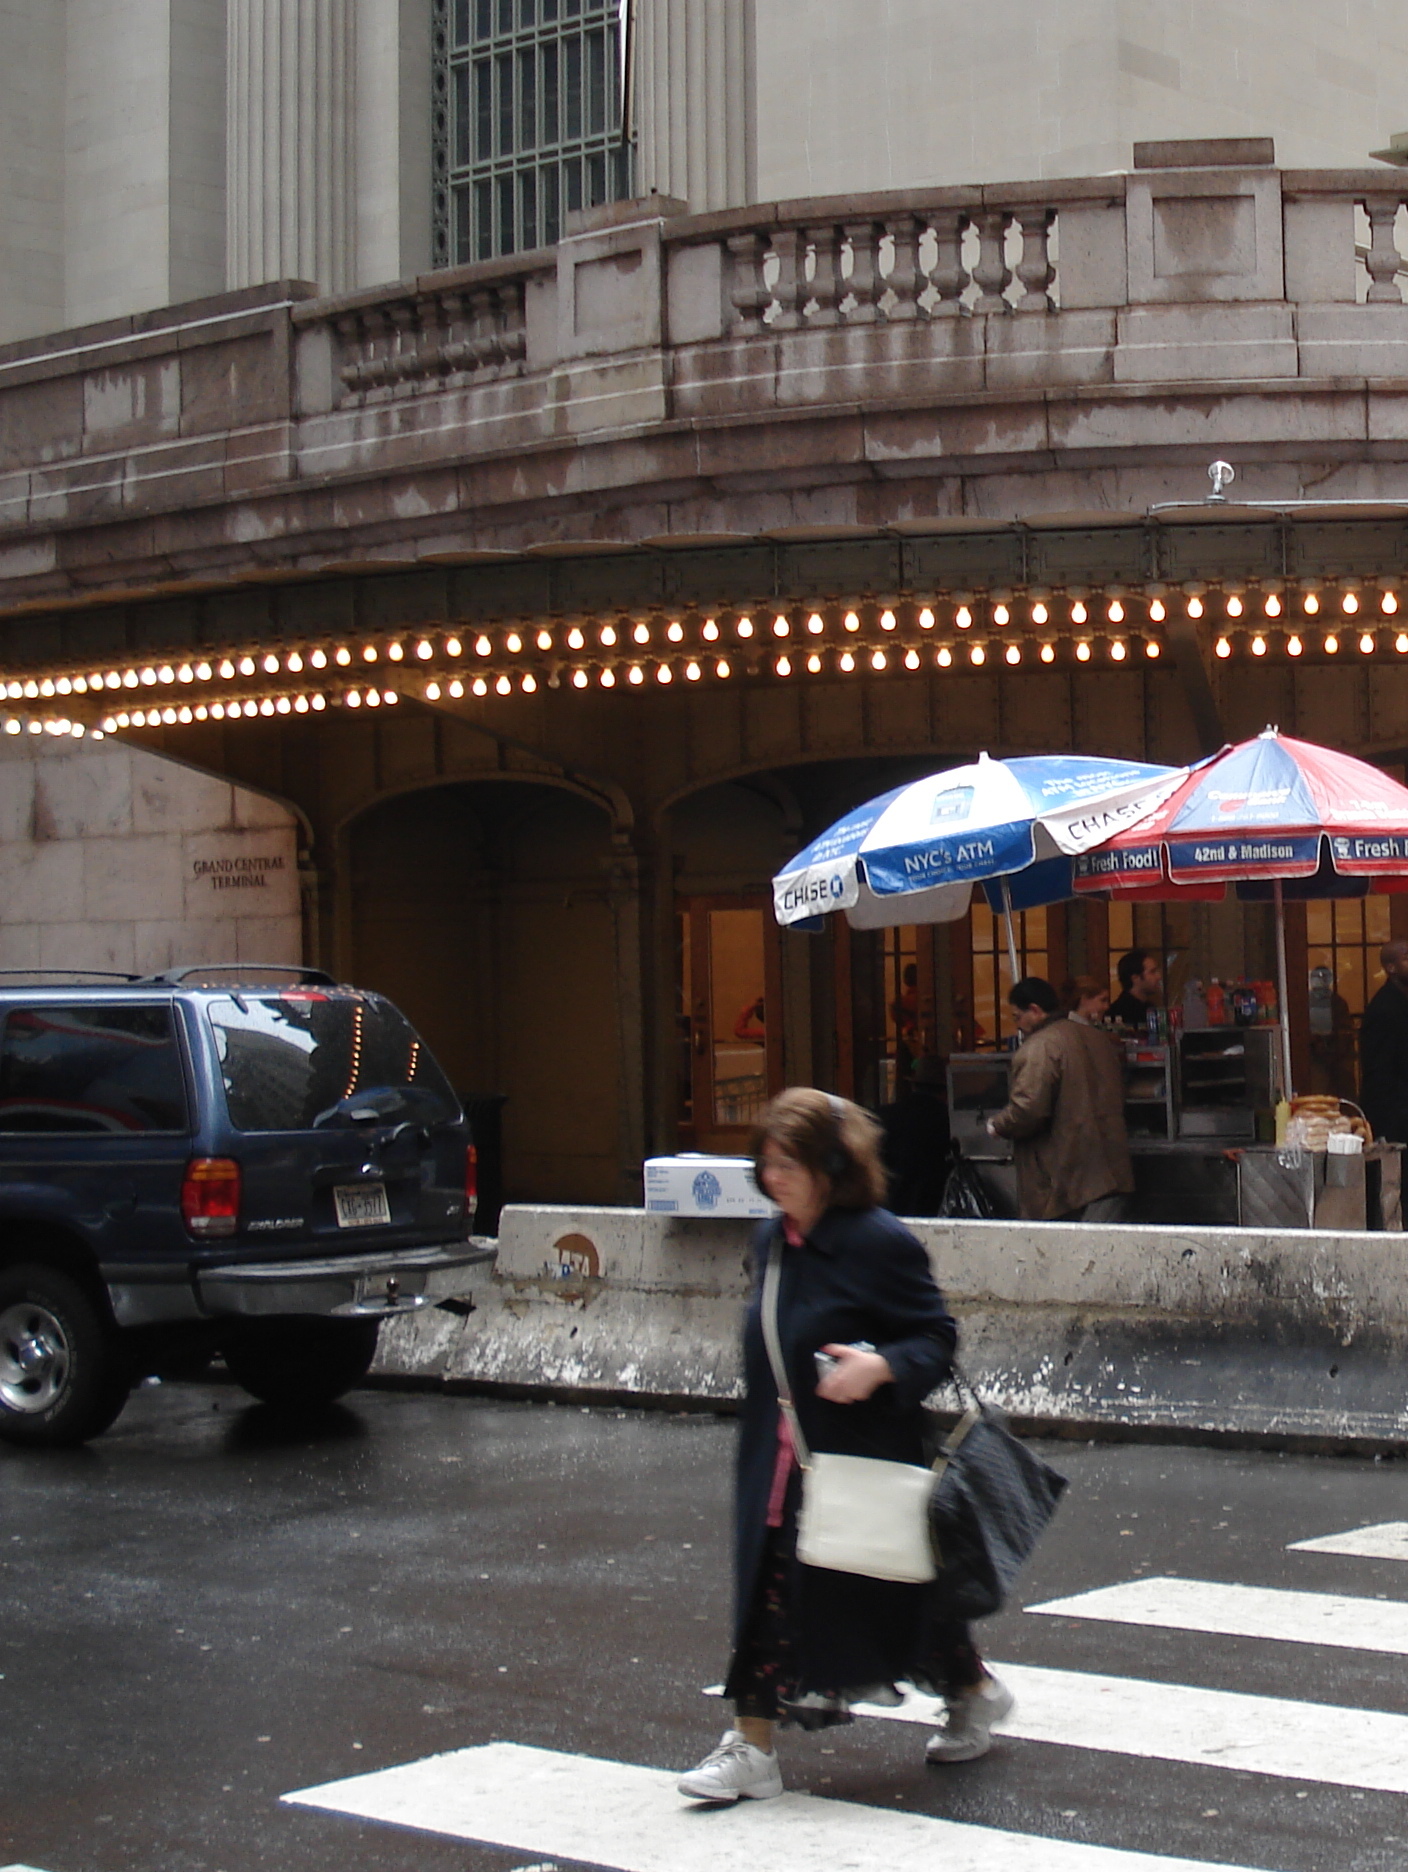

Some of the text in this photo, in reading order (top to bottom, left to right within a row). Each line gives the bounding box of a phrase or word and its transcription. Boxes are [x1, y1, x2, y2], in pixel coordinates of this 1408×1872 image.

[904, 839, 994, 874] NYC's ATM
[1194, 844, 1294, 862] 42nd & Madison
[1355, 838, 1400, 857] Fresh
[193, 857, 285, 874] GRAND CENTRAL
[1092, 848, 1158, 873] Fresh Food!
[212, 874, 267, 890] TERMINAL
[784, 879, 828, 910] CHASE
